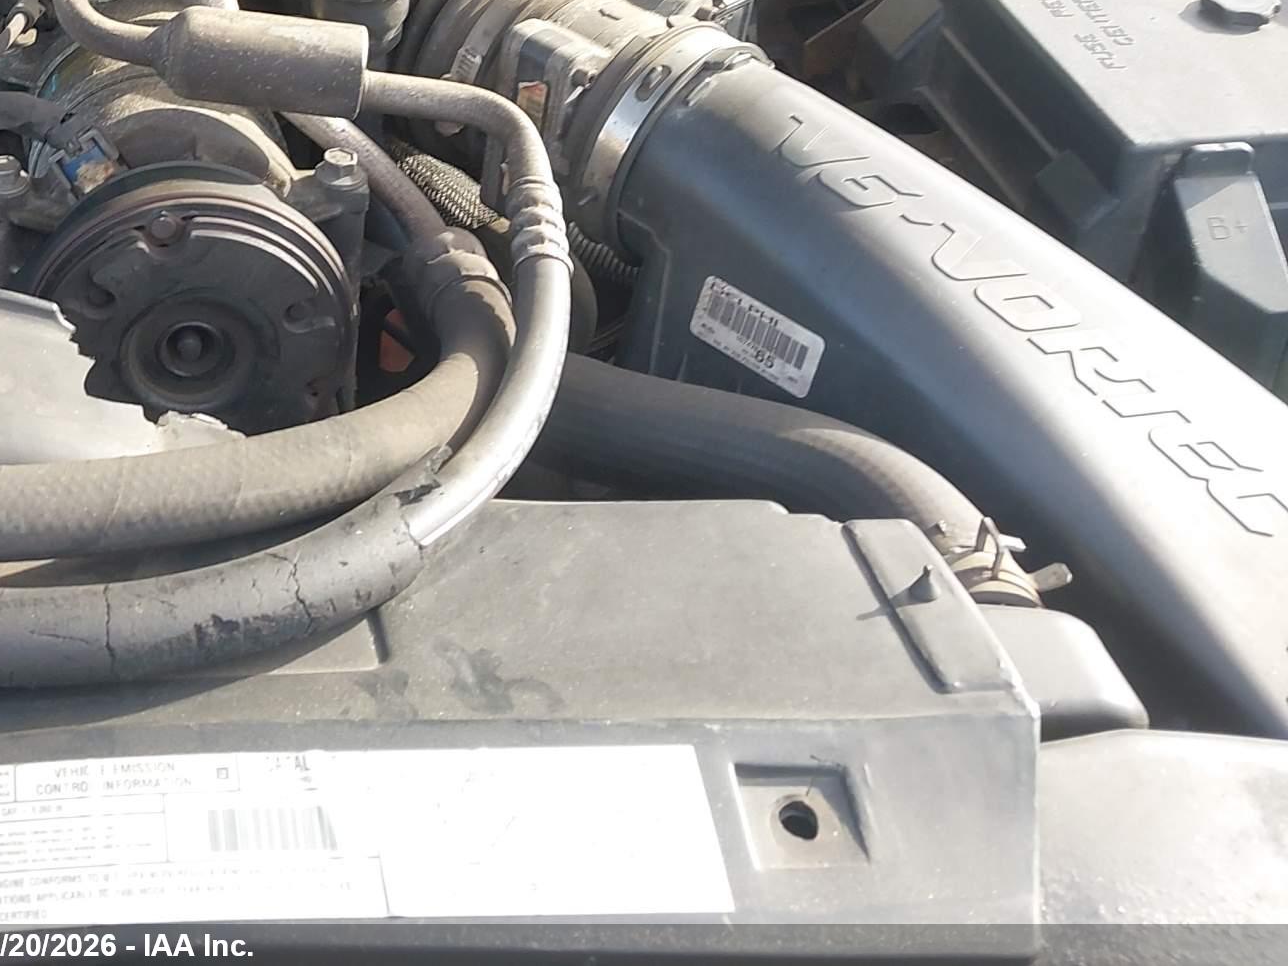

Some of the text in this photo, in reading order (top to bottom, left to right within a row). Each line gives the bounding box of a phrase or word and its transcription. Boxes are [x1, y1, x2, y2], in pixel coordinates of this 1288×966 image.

[1072, 32, 1128, 72] FUSE
[1206, 214, 1249, 241] B+
[54, 764, 105, 779] VEHICE
[35, 780, 95, 796] CONTRO
